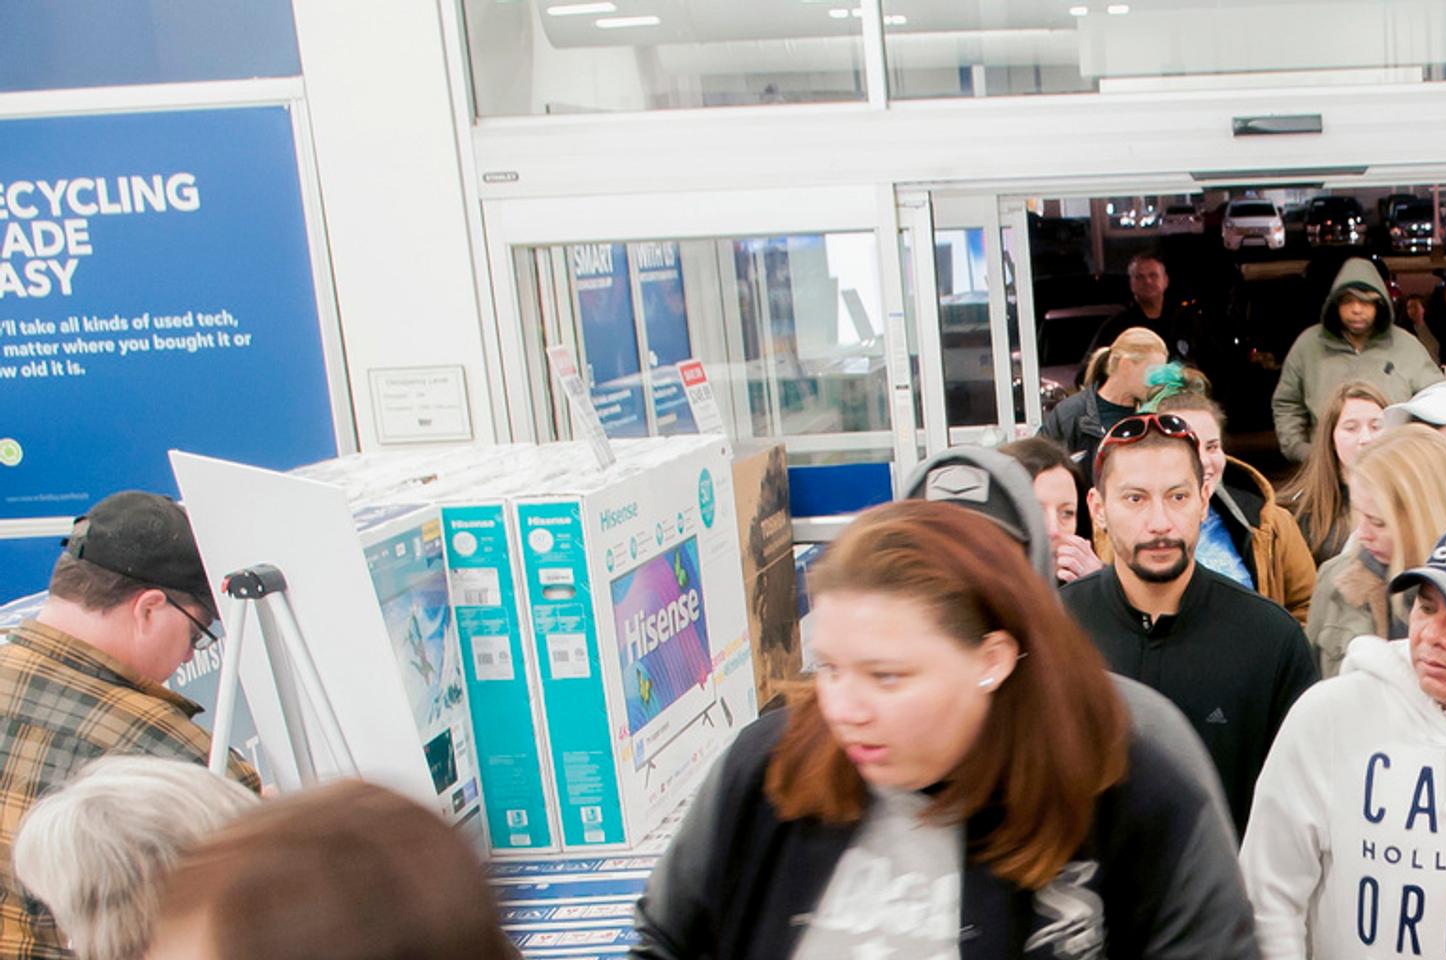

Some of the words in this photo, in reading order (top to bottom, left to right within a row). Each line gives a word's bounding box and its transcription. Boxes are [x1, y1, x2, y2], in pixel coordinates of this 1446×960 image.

[0, 172, 201, 220] CYCLING
[0, 218, 93, 258] ADE
[0, 258, 79, 298] ASY
[20, 318, 55, 335] take
[60, 316, 79, 333] all
[84, 314, 128, 333] kinds
[132, 312, 150, 330] of
[153, 311, 194, 329] used
[197, 309, 239, 328] tech,
[4, 340, 59, 358] matter
[62, 337, 115, 355] where
[119, 336, 150, 355] you
[153, 333, 215, 353] bought
[217, 331, 231, 347] it
[233, 333, 252, 347] or
[21, 361, 48, 378] old
[51, 360, 64, 376] it
[67, 360, 86, 376] is.
[600, 502, 638, 532] Hisense
[624, 588, 700, 663] Hisense
